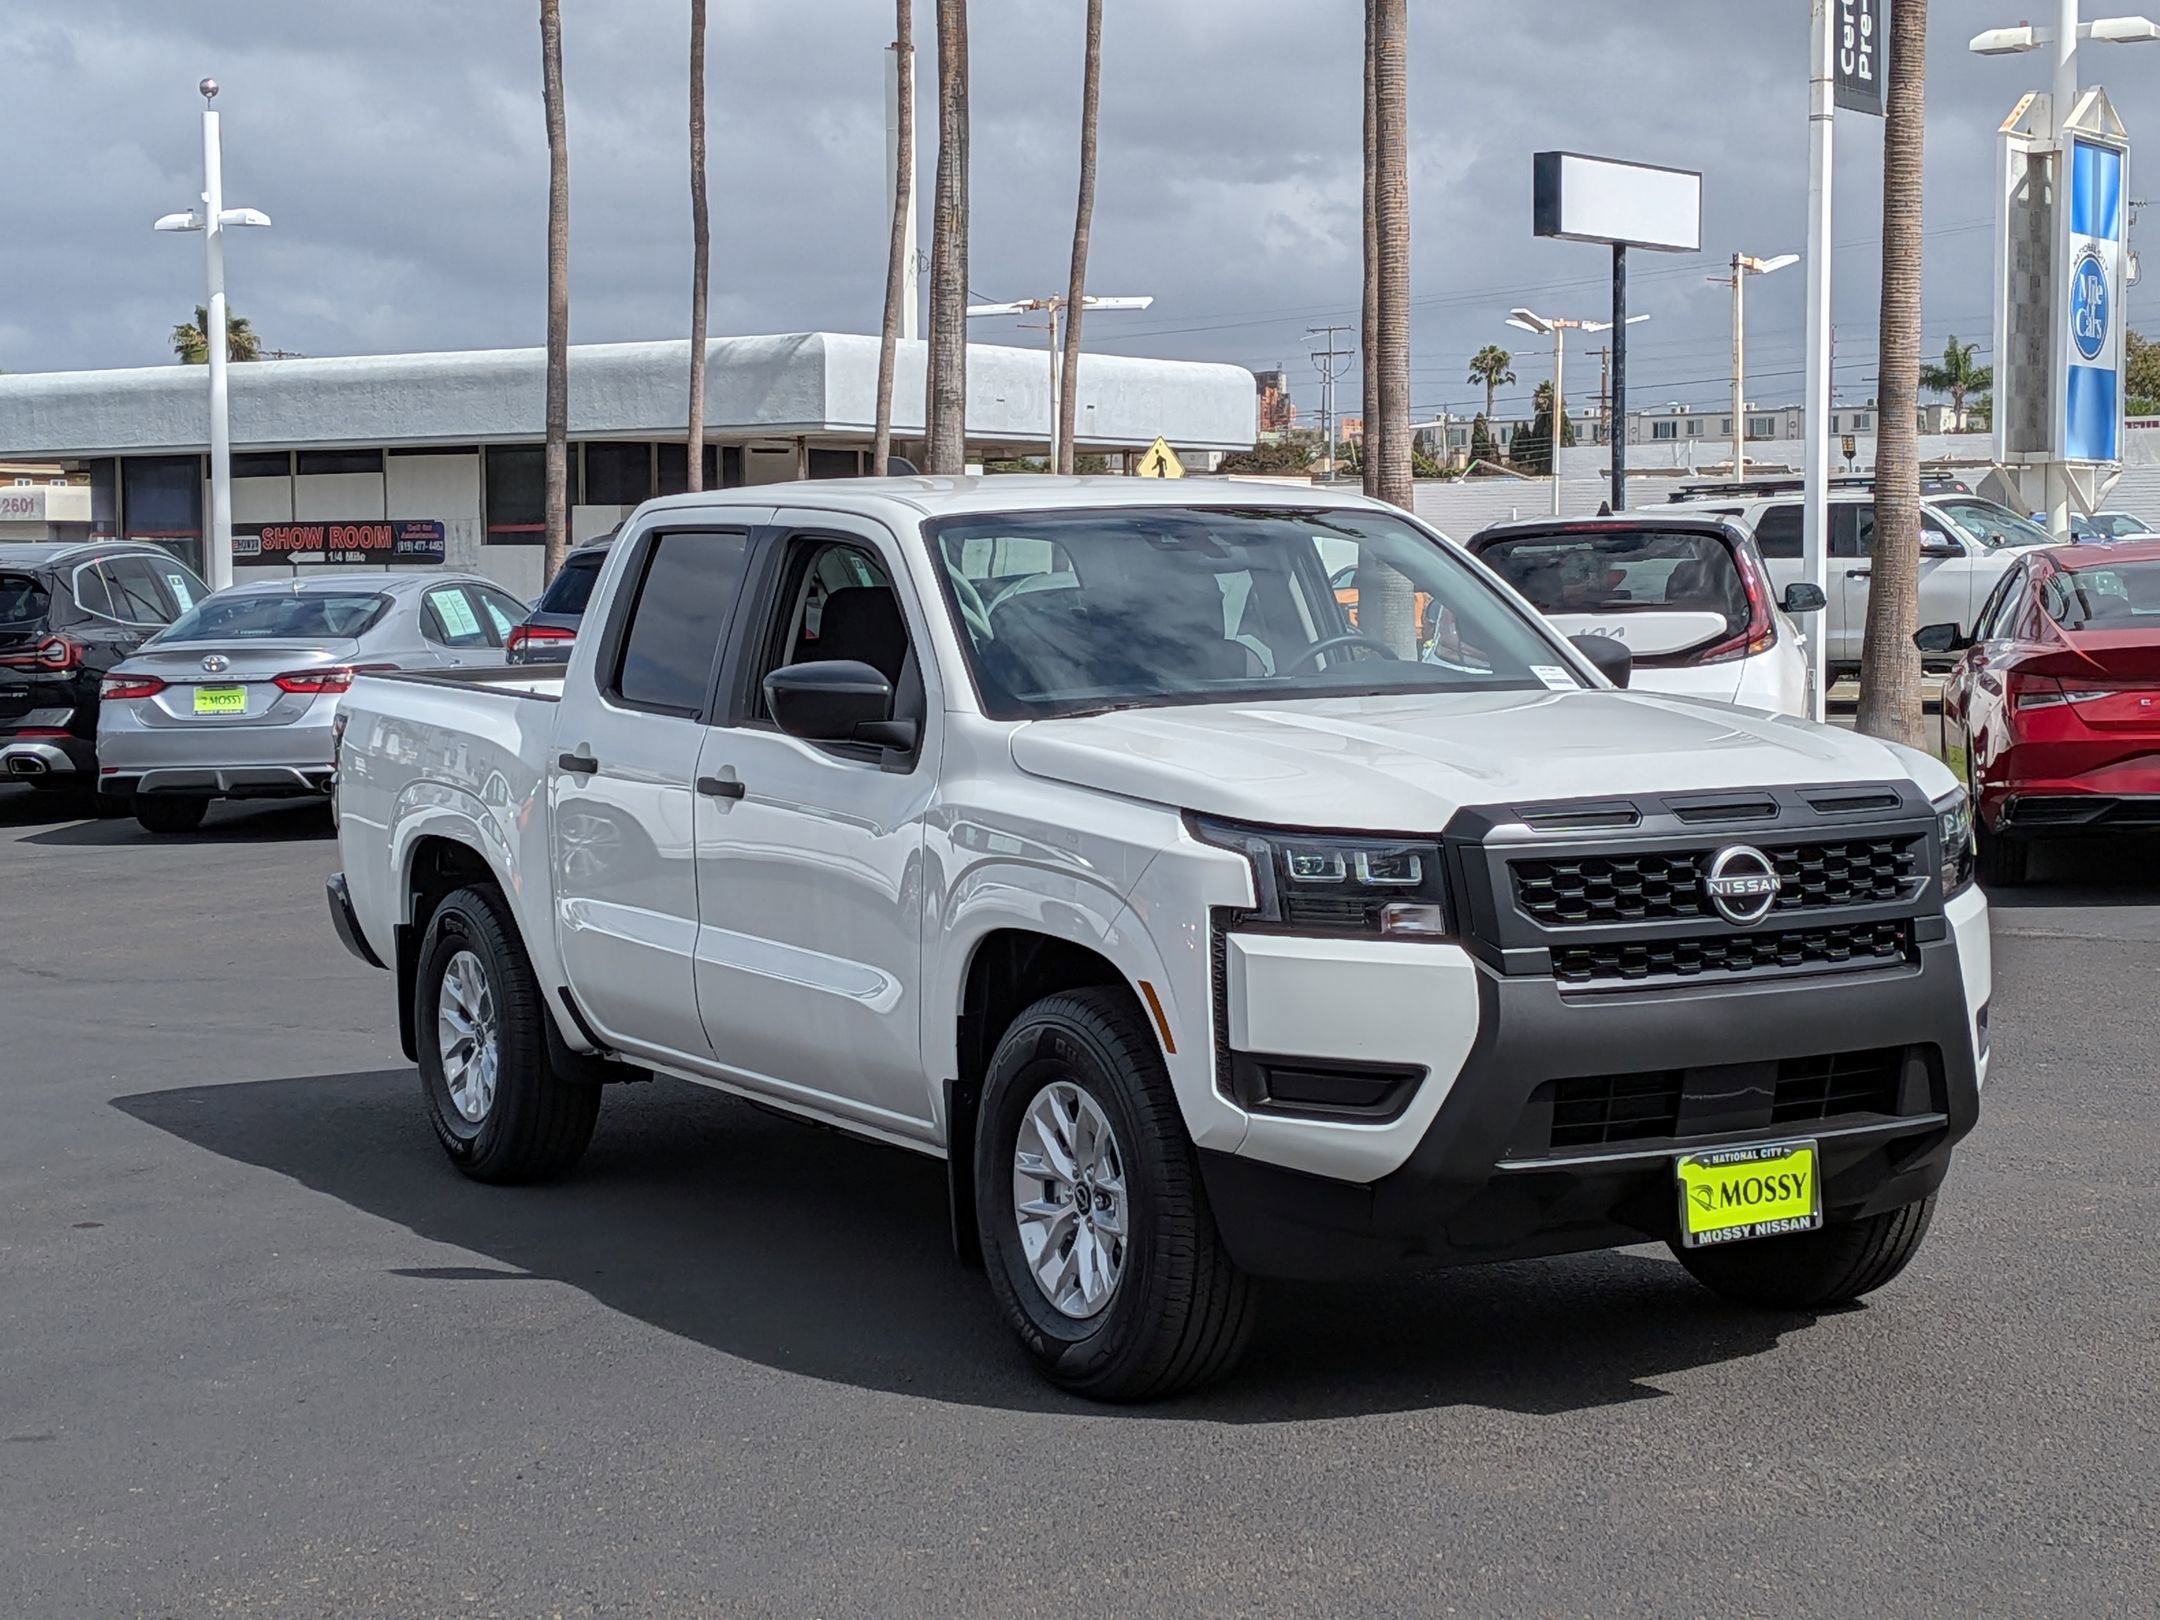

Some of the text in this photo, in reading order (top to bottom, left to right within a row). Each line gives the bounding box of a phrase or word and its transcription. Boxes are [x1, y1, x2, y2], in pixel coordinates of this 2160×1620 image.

[2076, 308, 2102, 339] Cars
[2, 498, 34, 512] 2601
[262, 527, 324, 550] SHOW
[329, 526, 392, 549] ROOM
[345, 551, 366, 562] Mile
[1709, 878, 1781, 895] NISSAN
[1712, 1147, 1782, 1164] NATIONAL CITY
[1720, 1172, 1807, 1209] MOSSY
[1699, 1216, 1810, 1244] MOSSY NISSAN
